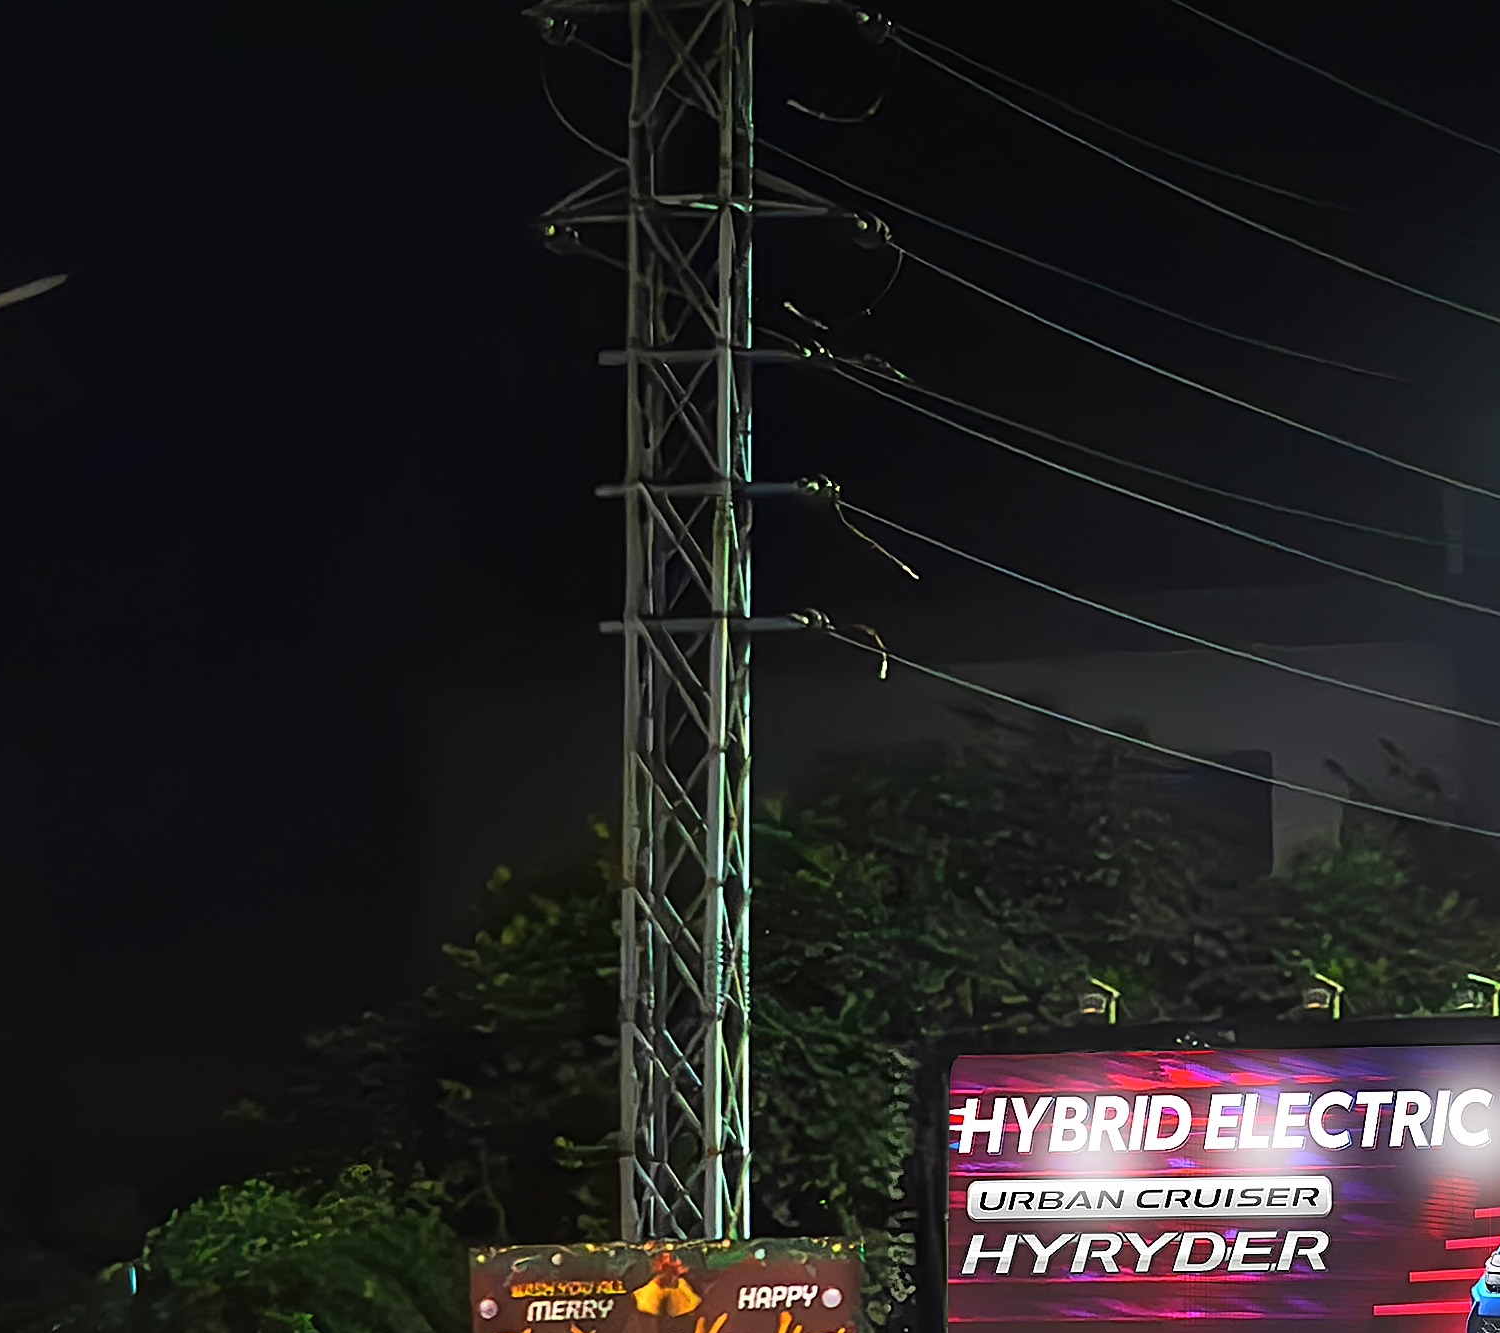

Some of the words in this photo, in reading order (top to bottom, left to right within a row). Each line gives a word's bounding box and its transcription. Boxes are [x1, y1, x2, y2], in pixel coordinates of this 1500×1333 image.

[957, 1097, 1191, 1153] HYBRID
[1204, 1091, 1491, 1150] ELECTRIC
[978, 1190, 1124, 1211] URBAN
[1134, 1187, 1319, 1208] CRUISER
[960, 1230, 1330, 1274] HYRYDER
[738, 1285, 818, 1310] HAPPY
[527, 1299, 614, 1322] MERRY
